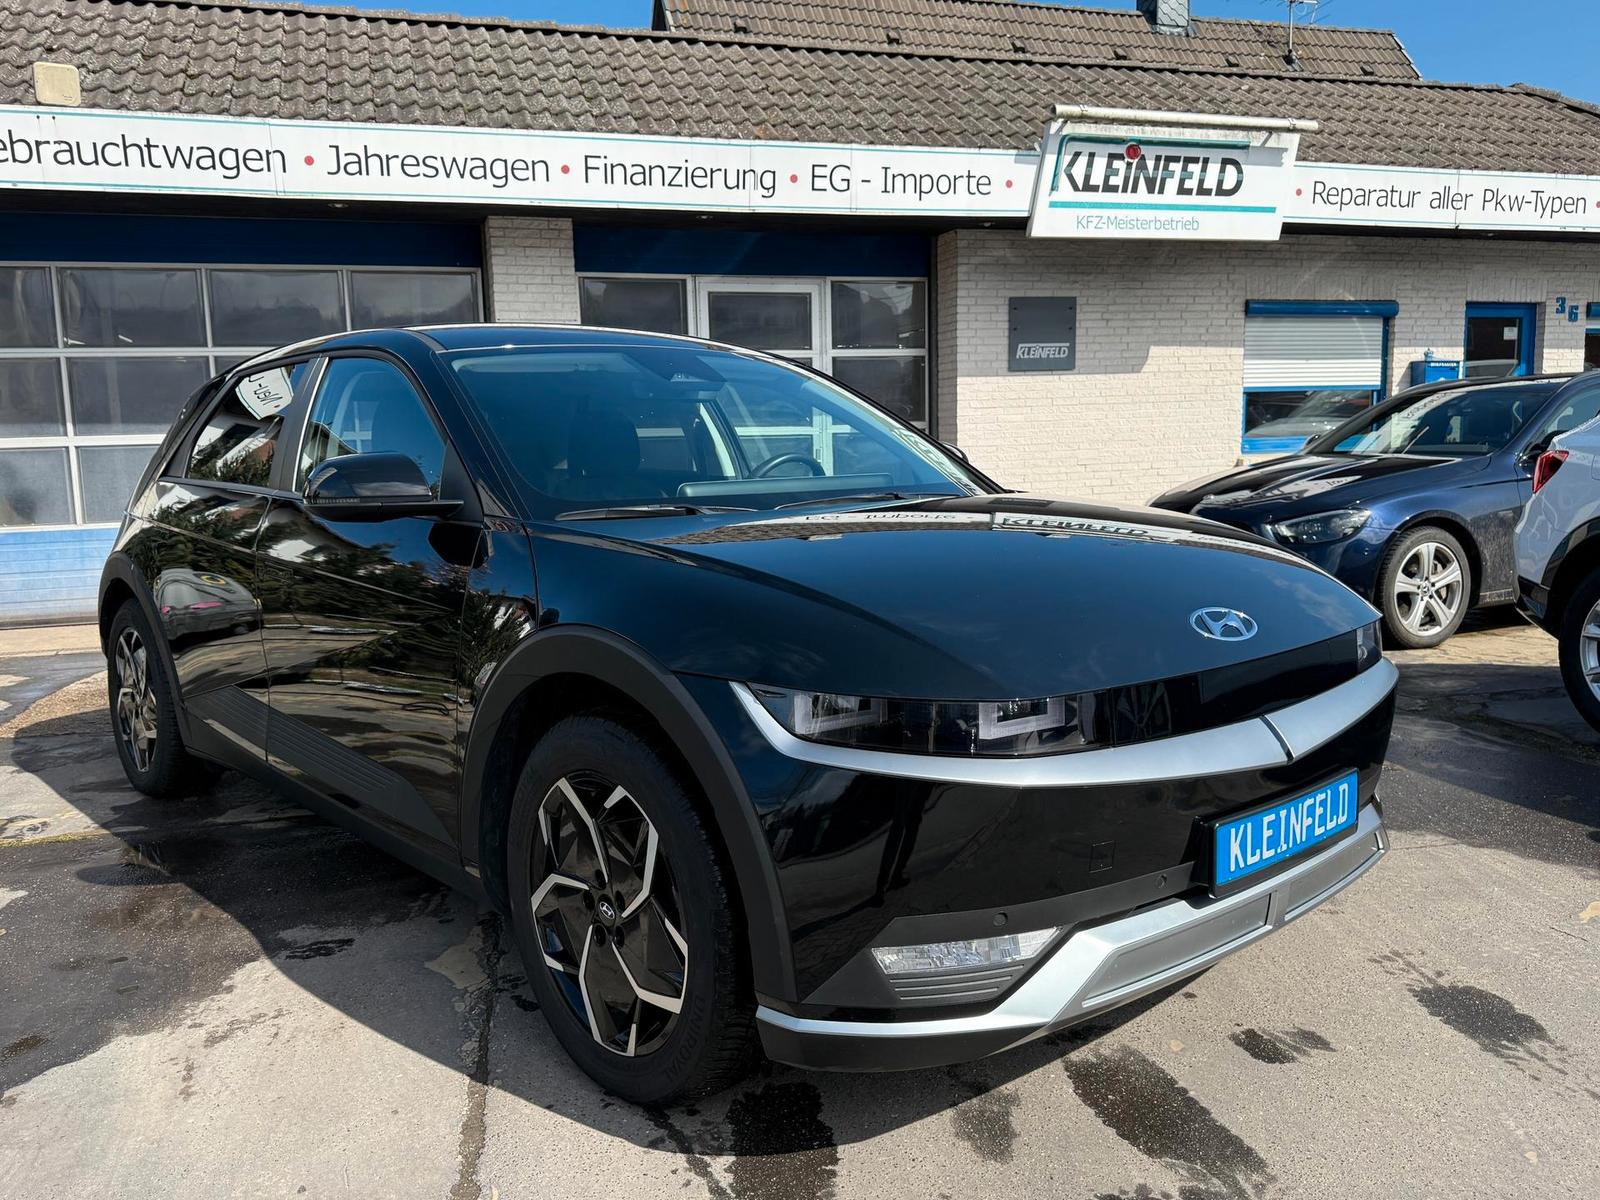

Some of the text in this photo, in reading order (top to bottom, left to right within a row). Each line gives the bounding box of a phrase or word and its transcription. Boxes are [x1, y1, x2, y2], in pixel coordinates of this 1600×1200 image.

[327, 144, 550, 189] Jahreswagen
[584, 154, 776, 199] Finanzierung
[811, 164, 851, 193] EG
[881, 166, 991, 201] Importe
[1064, 143, 1244, 197] KLEINFELD
[1312, 180, 1587, 219] Reparatur aller Pkw-Typen
[1076, 215, 1200, 231] KFZ-Meisterbetrieb
[1016, 344, 1069, 359] KLEINFELD
[1230, 783, 1349, 872] KLEINFELD
